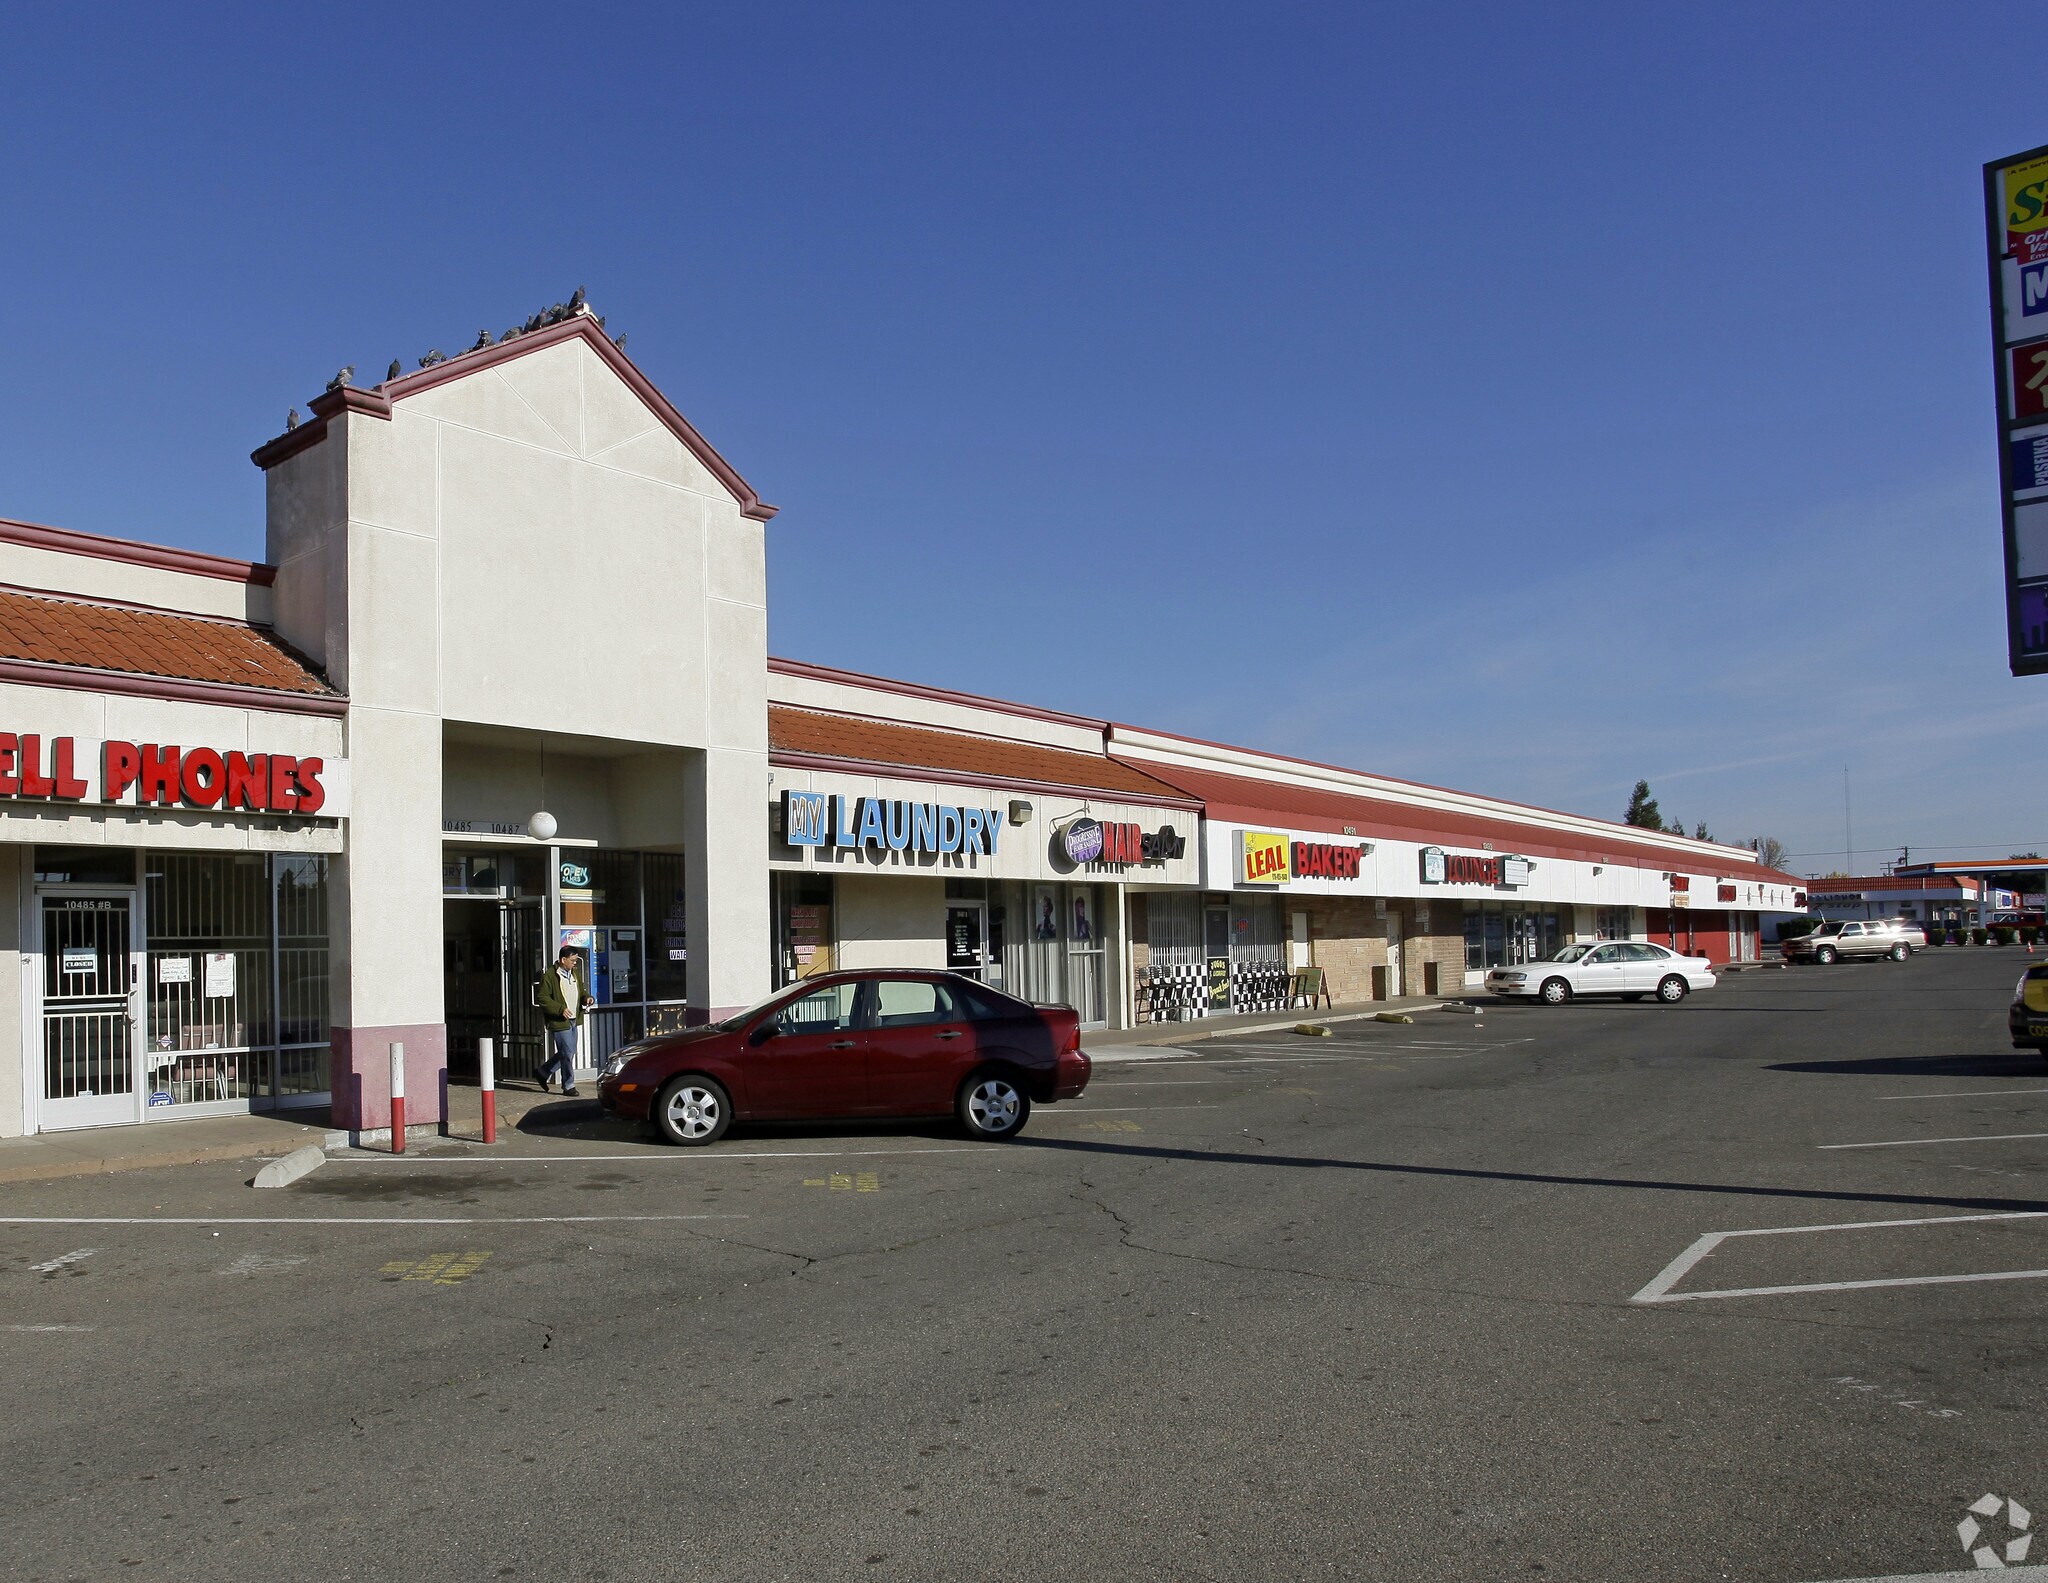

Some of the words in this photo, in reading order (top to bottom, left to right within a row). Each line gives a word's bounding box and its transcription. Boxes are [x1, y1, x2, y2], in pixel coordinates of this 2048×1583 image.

[102, 740, 326, 815] PHONES
[492, 823, 520, 834] 10487
[792, 797, 822, 840] MY
[832, 794, 1005, 856] LAUNDRY
[1102, 821, 1143, 864] HAIR
[1143, 826, 1186, 860] SALON
[563, 867, 588, 877] OPEN
[1246, 844, 1286, 880] LEAL
[1293, 842, 1363, 879] BAKERY
[1447, 856, 1499, 885] LOUNGE
[65, 901, 95, 909] 10485
[98, 901, 112, 910] #B
